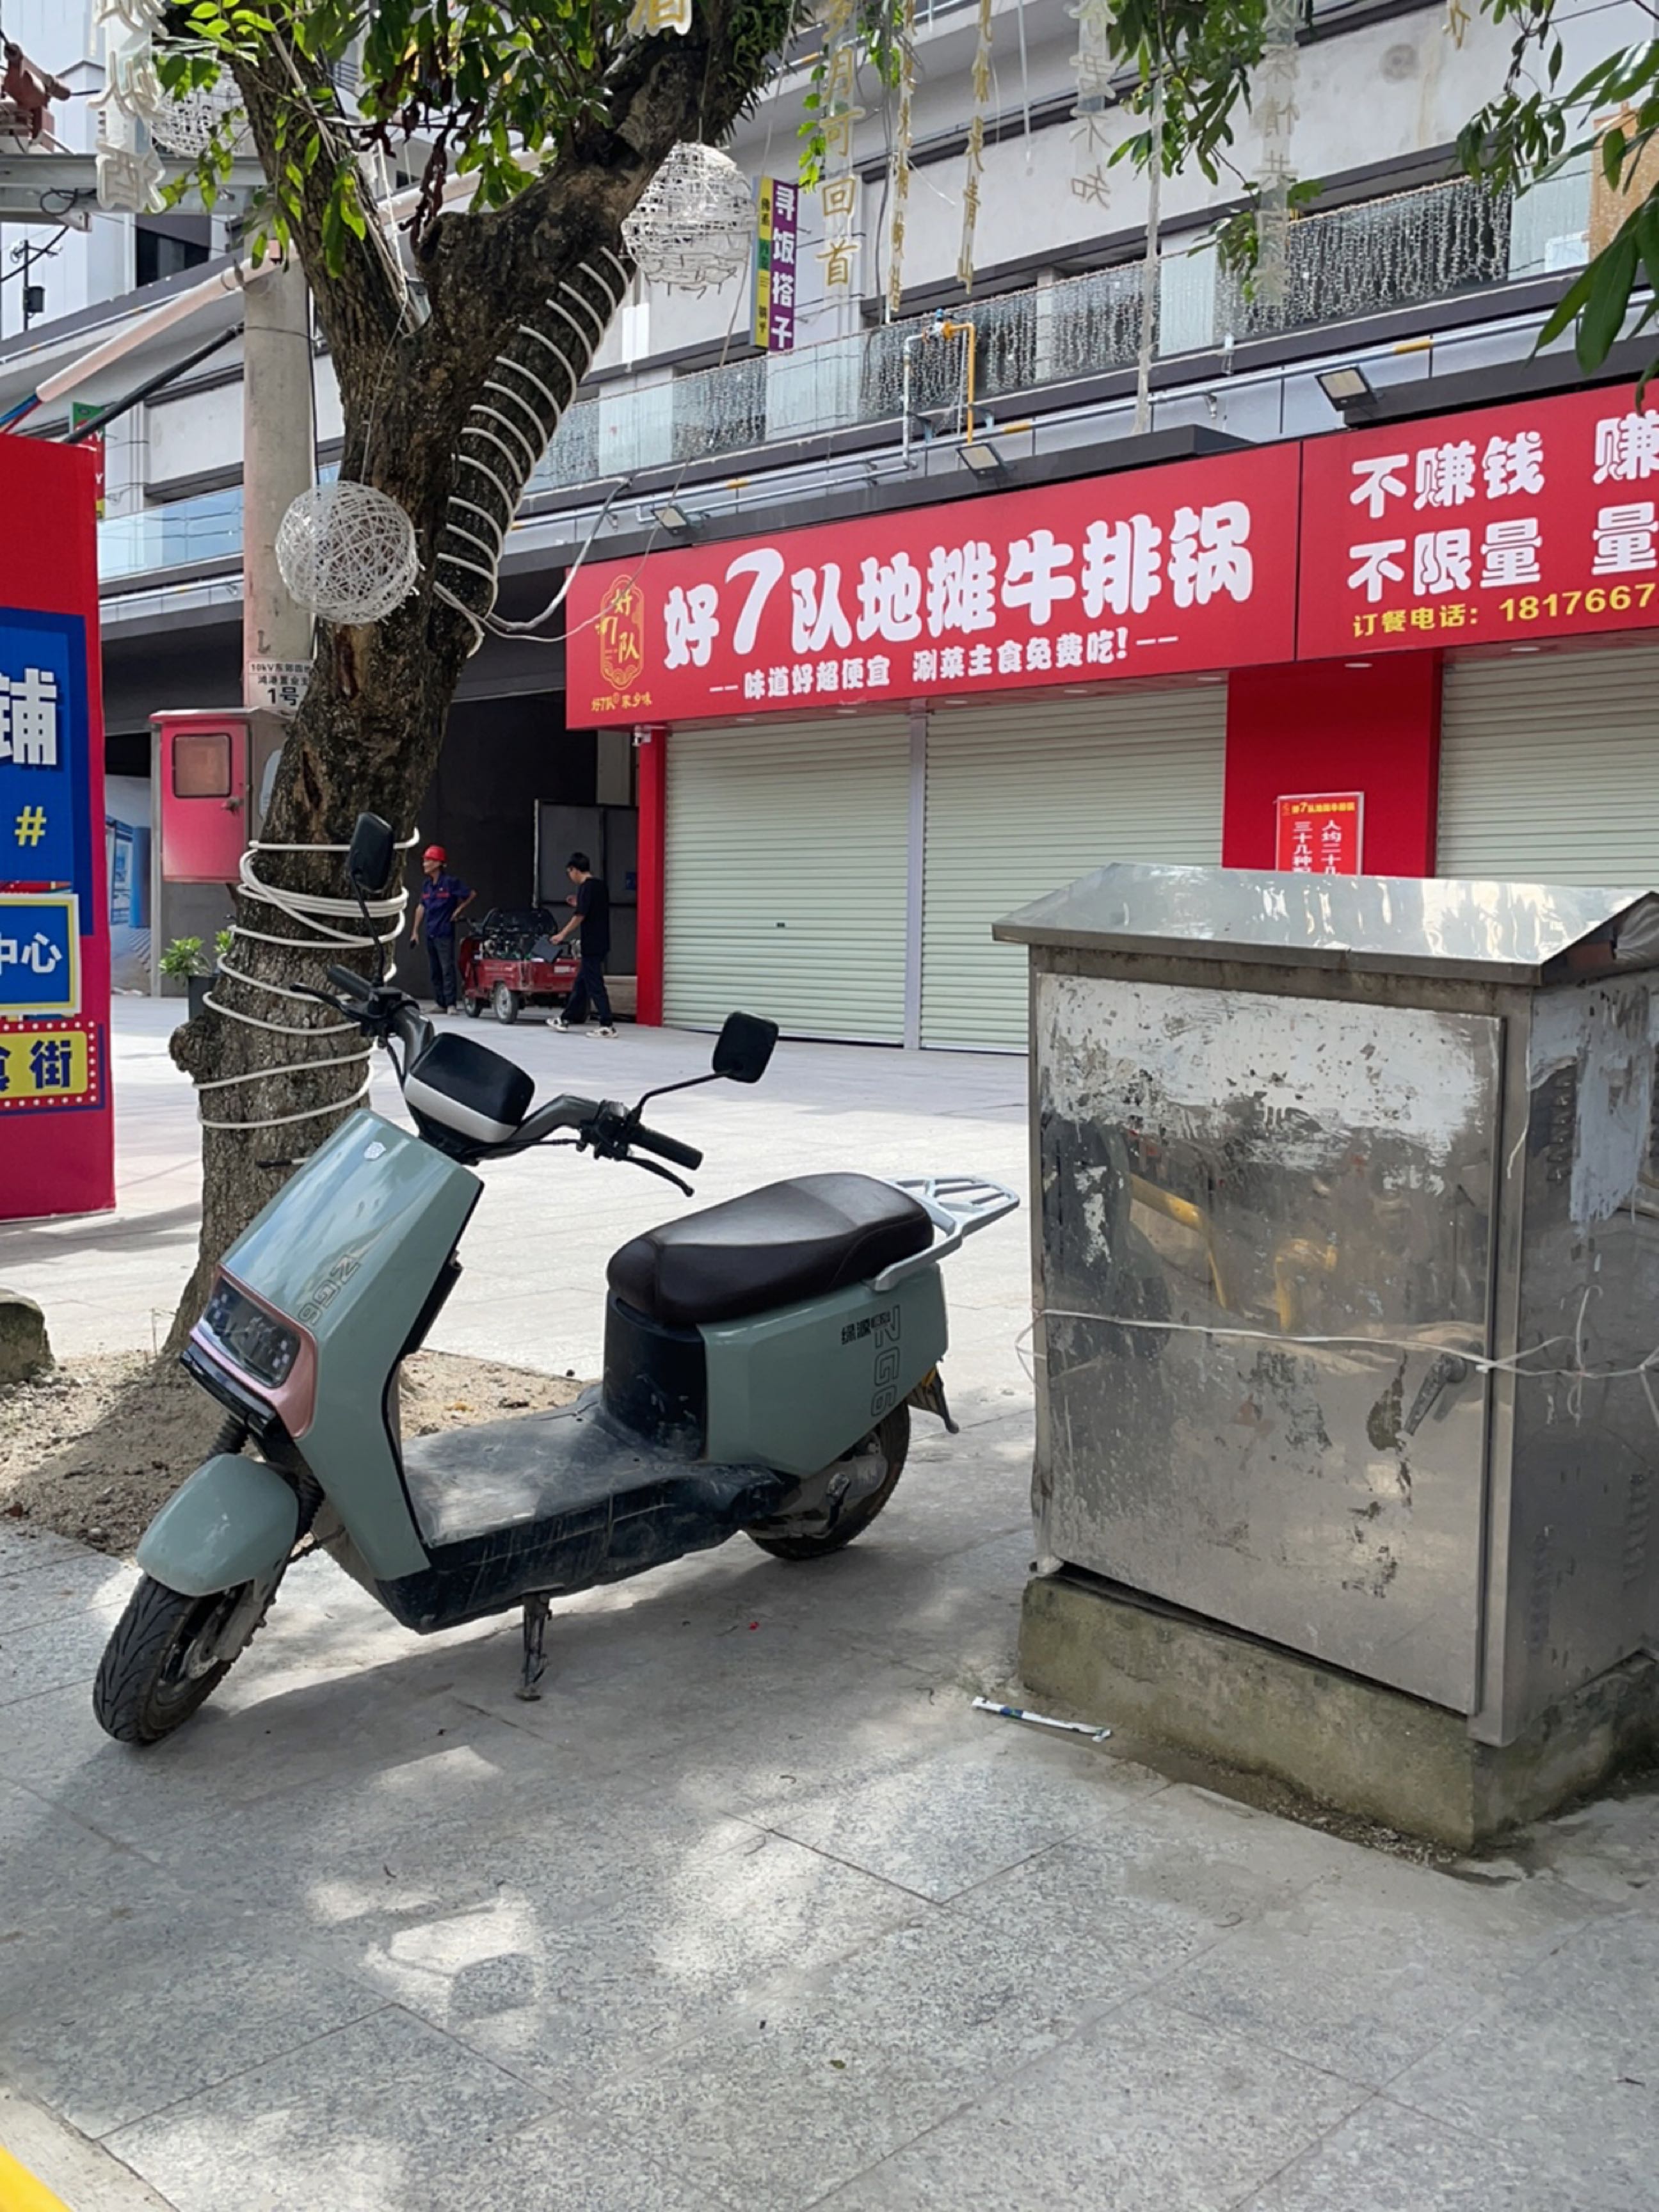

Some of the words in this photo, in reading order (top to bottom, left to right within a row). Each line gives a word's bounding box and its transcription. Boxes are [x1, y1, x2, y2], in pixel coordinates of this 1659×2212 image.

[771, 185, 795, 349] 寻饭搭子
[1349, 431, 1544, 519] 不赚钱
[664, 501, 1253, 669] 好7队地摊牛排锅
[1347, 517, 1542, 602] 不限量
[1591, 501, 1659, 575] 量
[1498, 583, 1655, 621] 1817667
[0, 668, 58, 766] 铺
[267, 686, 299, 706] 1号
[0, 1040, 72, 1090] 街
